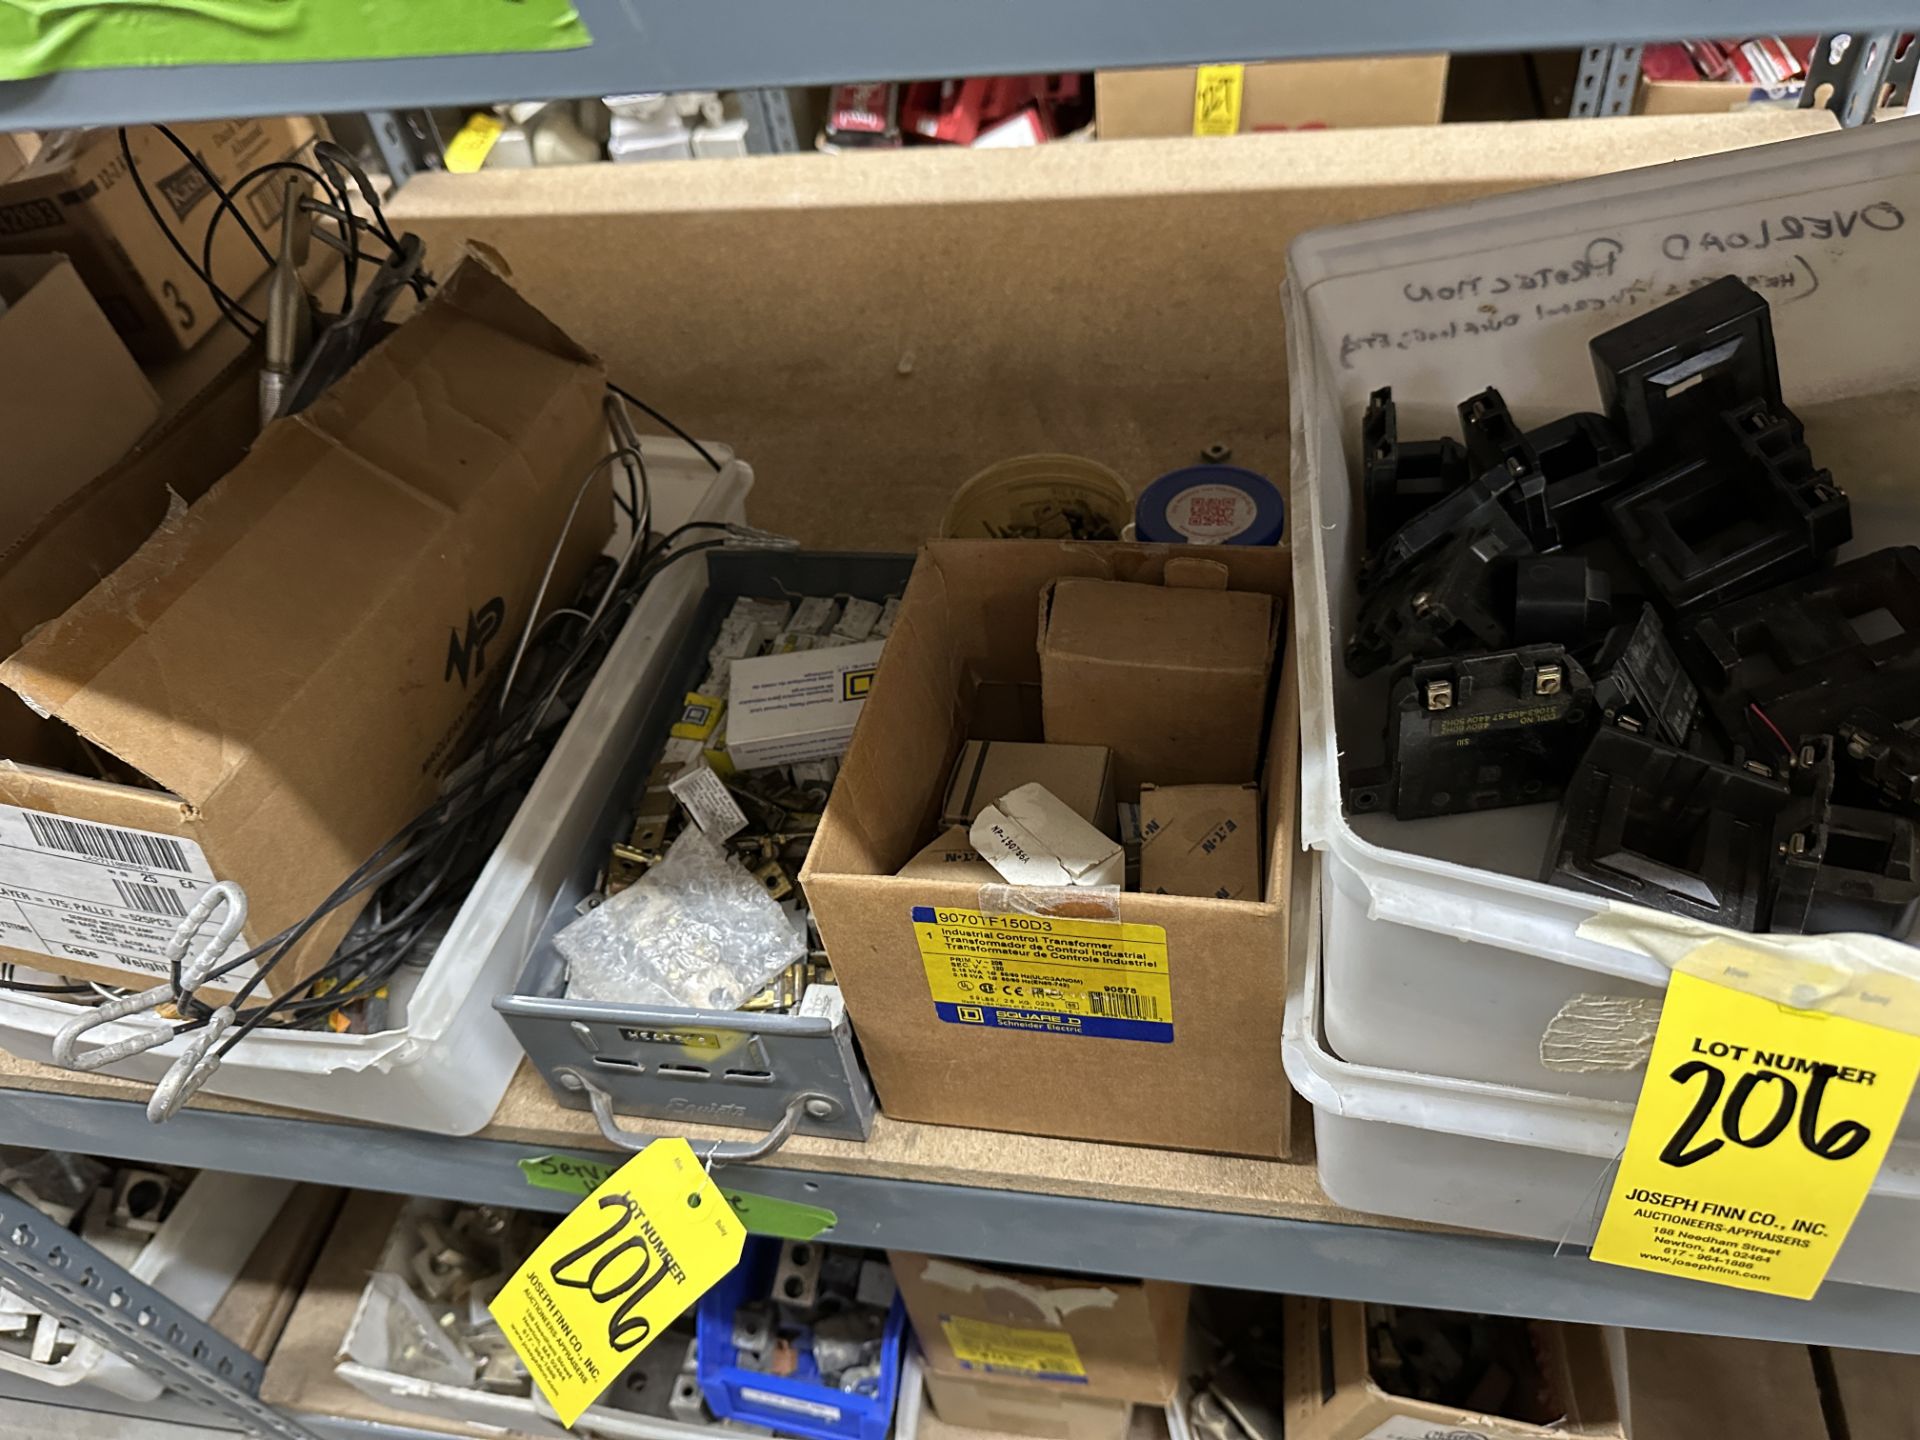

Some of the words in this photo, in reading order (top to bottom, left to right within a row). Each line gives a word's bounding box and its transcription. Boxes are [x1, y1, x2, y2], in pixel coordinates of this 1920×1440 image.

[163, 280, 195, 330] 3
[444, 596, 505, 689] NP
[141, 872, 158, 884] 25
[179, 879, 197, 890] EA
[74, 903, 114, 918] PALLET
[941, 928, 994, 940] Industrial
[996, 932, 1039, 943] Control
[1041, 936, 1113, 950] Transformer
[943, 935, 1027, 951] Transformador
[1030, 942, 1044, 951] de
[1046, 944, 1089, 957] Control
[1092, 948, 1146, 960] Industrial
[62, 943, 99, 960] Case
[114, 952, 170, 974] Weight
[945, 942, 1031, 958] Transformateur
[1034, 949, 1048, 959] de
[1102, 955, 1157, 969] Industriel
[996, 1011, 1061, 1023] SQUARE
[1068, 1016, 1081, 1025] D
[997, 1019, 1043, 1030] Schneider
[1047, 1023, 1083, 1034] Electric
[1692, 1038, 1749, 1061] LOT
[1659, 1060, 1871, 1168] 206
[1625, 1189, 1698, 1213] JOSEPH
[1700, 1201, 1747, 1221] FINN
[1748, 1211, 1786, 1231] CO.,
[1791, 1218, 1829, 1238] INC.
[1633, 1208, 1811, 1249] AUCTIONEERS-APPRAISERS
[1653, 1226, 1675, 1236] 188
[1678, 1230, 1739, 1249] Needham
[1742, 1242, 1781, 1257] Street
[1654, 1235, 1705, 1252] Newton,
[1709, 1246, 1730, 1256] MA
[1732, 1249, 1772, 1263] 02464
[1663, 1247, 1687, 1257] 617
[550, 1193, 669, 1352] 206
[1639, 1252, 1771, 1282] www.josephfinn.com
[526, 1272, 557, 1312] JOSEPH
[552, 1308, 573, 1337] FINN
[584, 1357, 600, 1383] INC.
